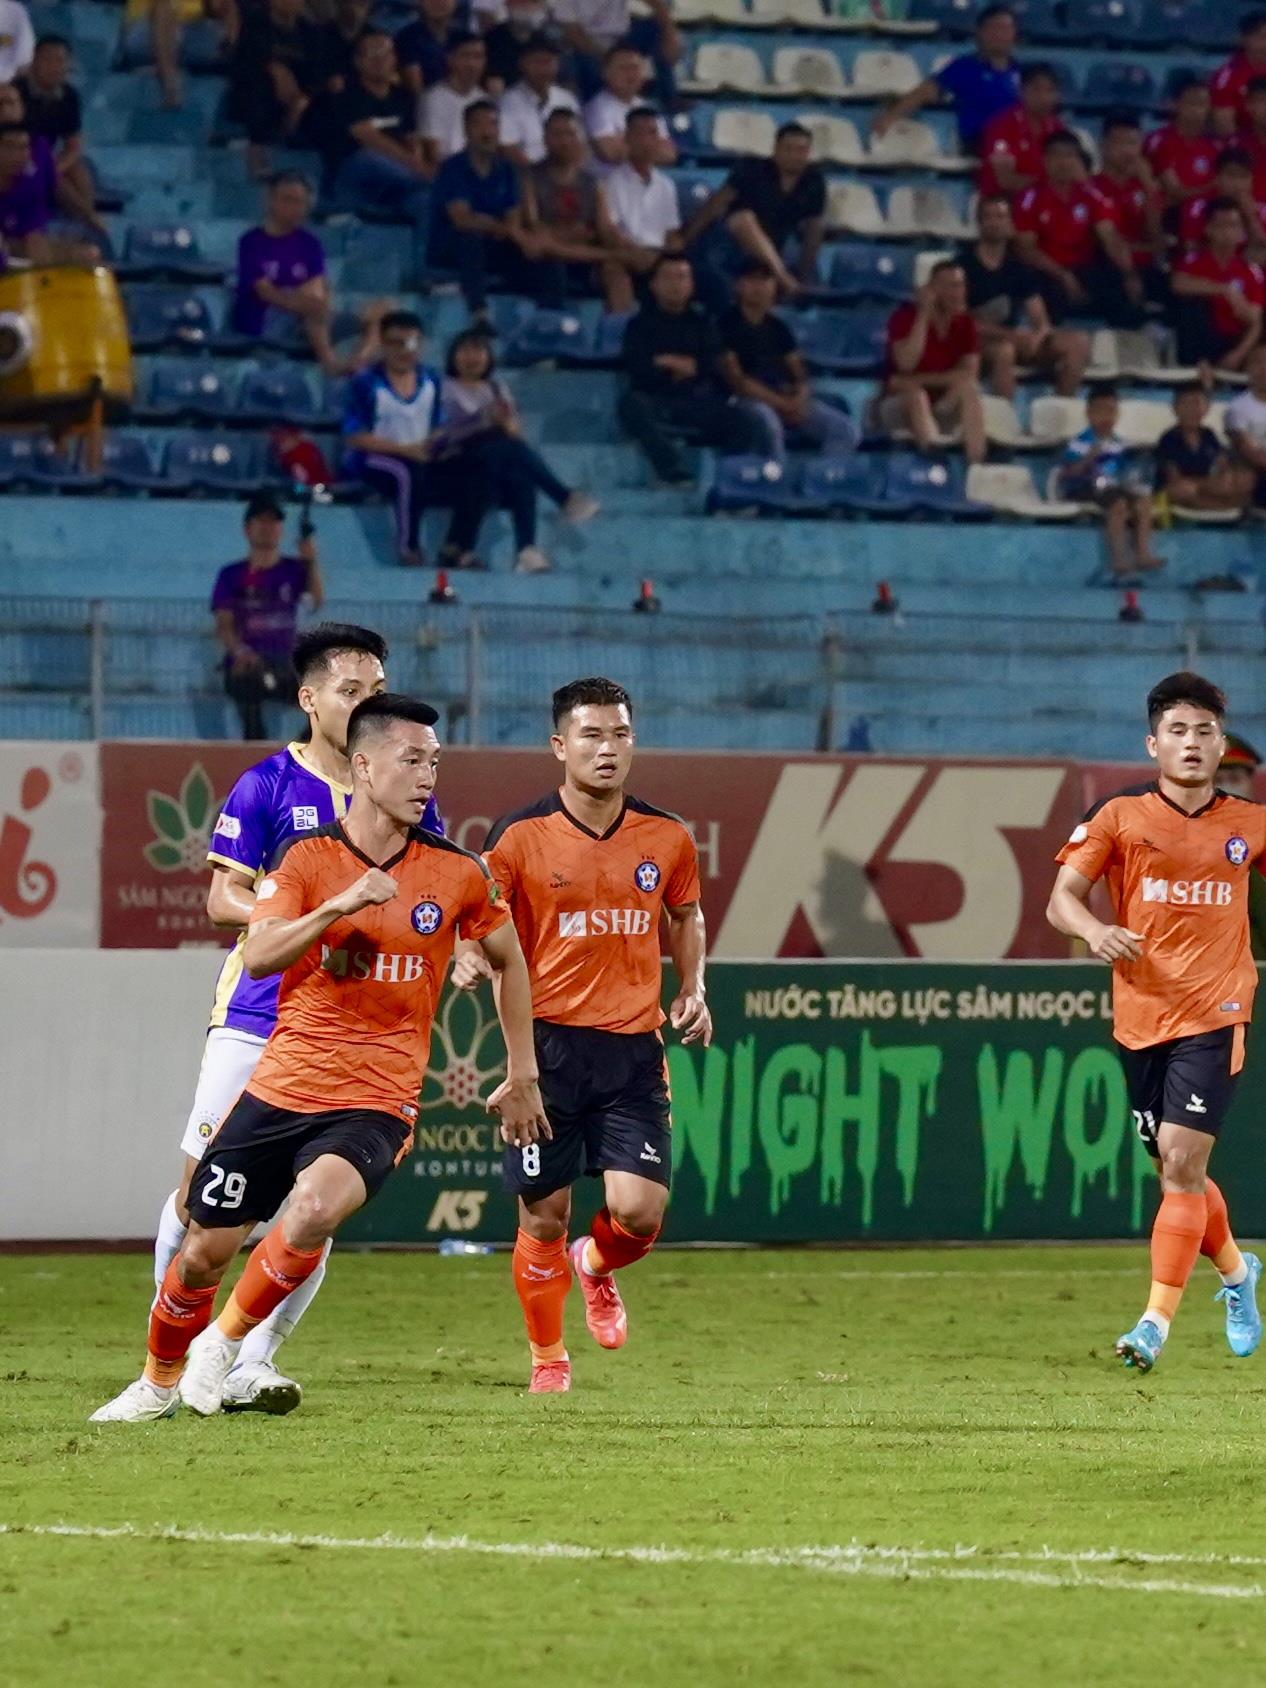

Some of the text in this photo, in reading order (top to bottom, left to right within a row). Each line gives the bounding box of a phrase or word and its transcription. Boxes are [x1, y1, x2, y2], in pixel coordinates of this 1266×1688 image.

[707, 764, 1067, 957] K5
[1171, 881, 1232, 905] SHB
[591, 908, 651, 936] SHB
[352, 951, 424, 983] SHB
[827, 984, 896, 1019] TĂNG
[902, 990, 950, 1026] LỰC
[956, 985, 1012, 1020] SÂM
[1017, 991, 1095, 1026] NGỌC
[668, 1029, 942, 1228] NIGHT
[522, 1143, 541, 1177] 8
[202, 1164, 247, 1208] 29
[426, 1190, 488, 1232] K5
